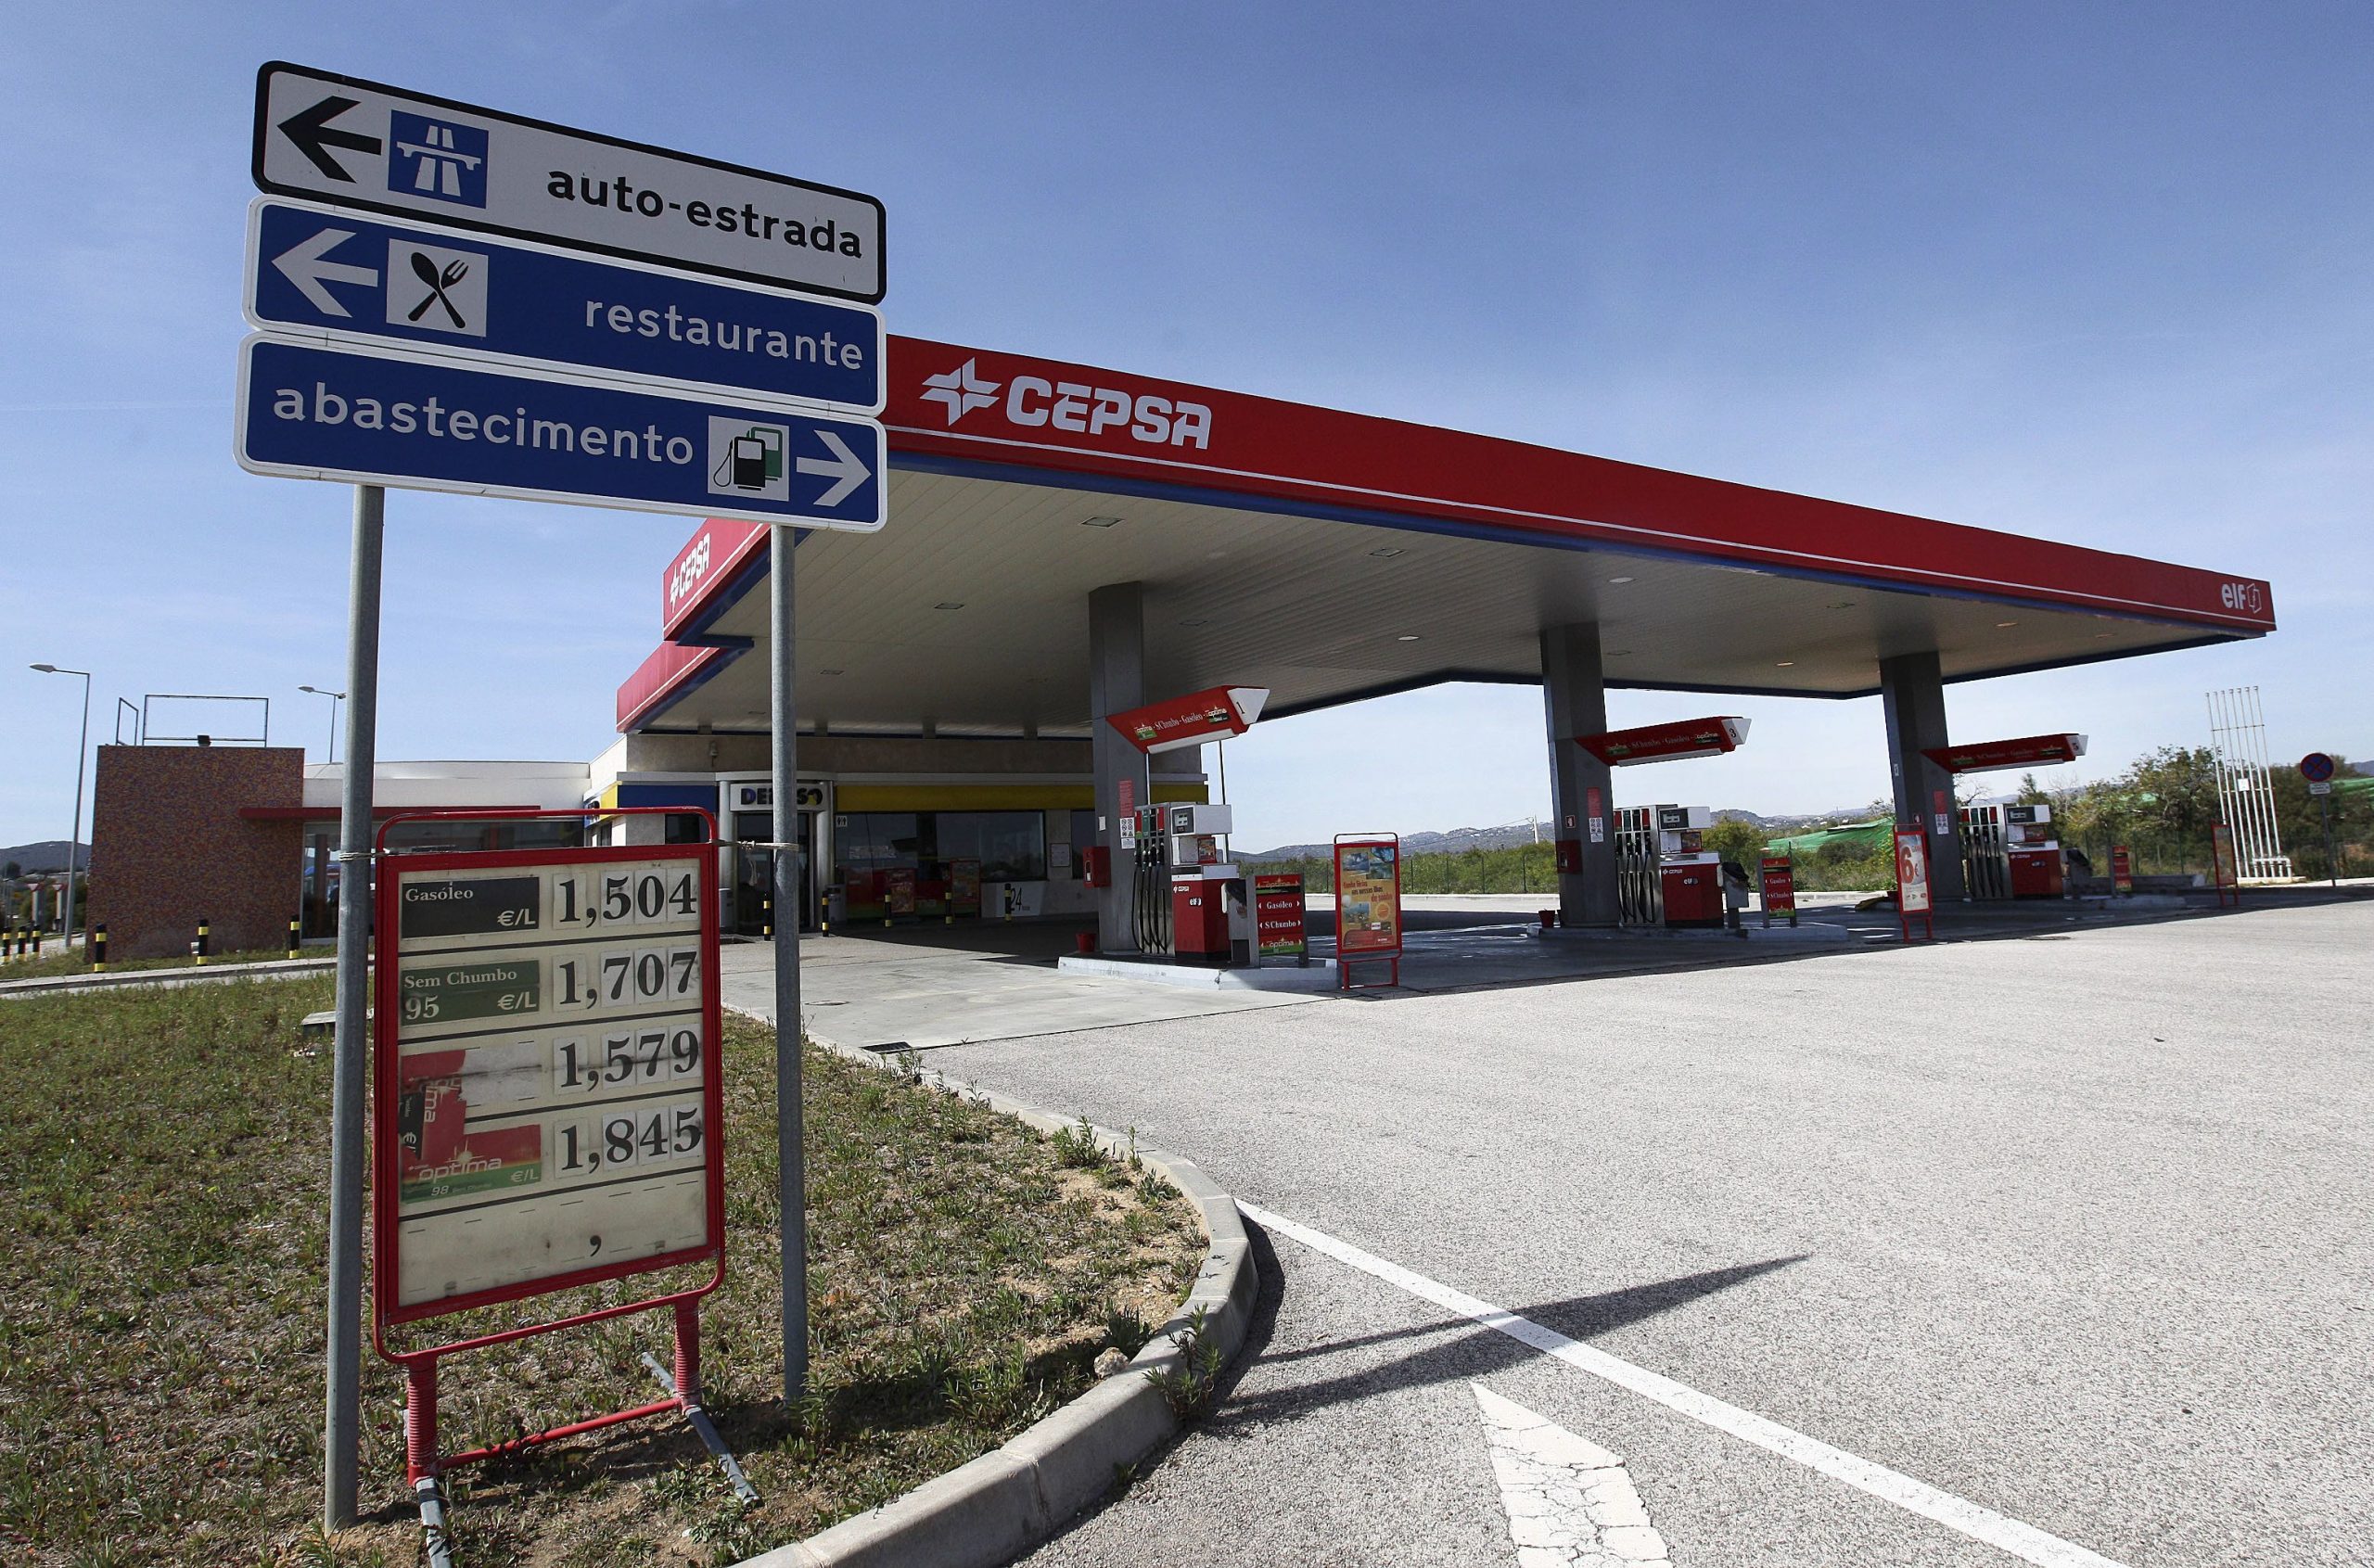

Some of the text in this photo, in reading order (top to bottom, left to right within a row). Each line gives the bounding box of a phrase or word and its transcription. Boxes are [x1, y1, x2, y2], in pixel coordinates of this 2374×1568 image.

[546, 171, 862, 259] auto-estrada
[585, 300, 863, 370] restaurante
[273, 381, 694, 465] abastecimento
[1006, 376, 1212, 450] CEPSA
[679, 532, 710, 598] CEPSA
[2221, 582, 2246, 610] elf
[1729, 728, 1737, 738] 3
[740, 787, 823, 805] DESO
[1899, 846, 1915, 884] 6
[405, 886, 536, 926] Gasóleo €/L
[559, 873, 697, 928] 1,504
[1266, 900, 1293, 910] Gasóleo
[404, 968, 517, 988] Sem Chumbo
[559, 950, 697, 1010] 1,707
[405, 991, 537, 1020] 95 €/L
[559, 1029, 699, 1092] 1,579
[561, 1107, 702, 1174] 1,845
[419, 1158, 502, 1184] optima
[431, 1185, 450, 1196] 98
[510, 1168, 540, 1182] €/L
